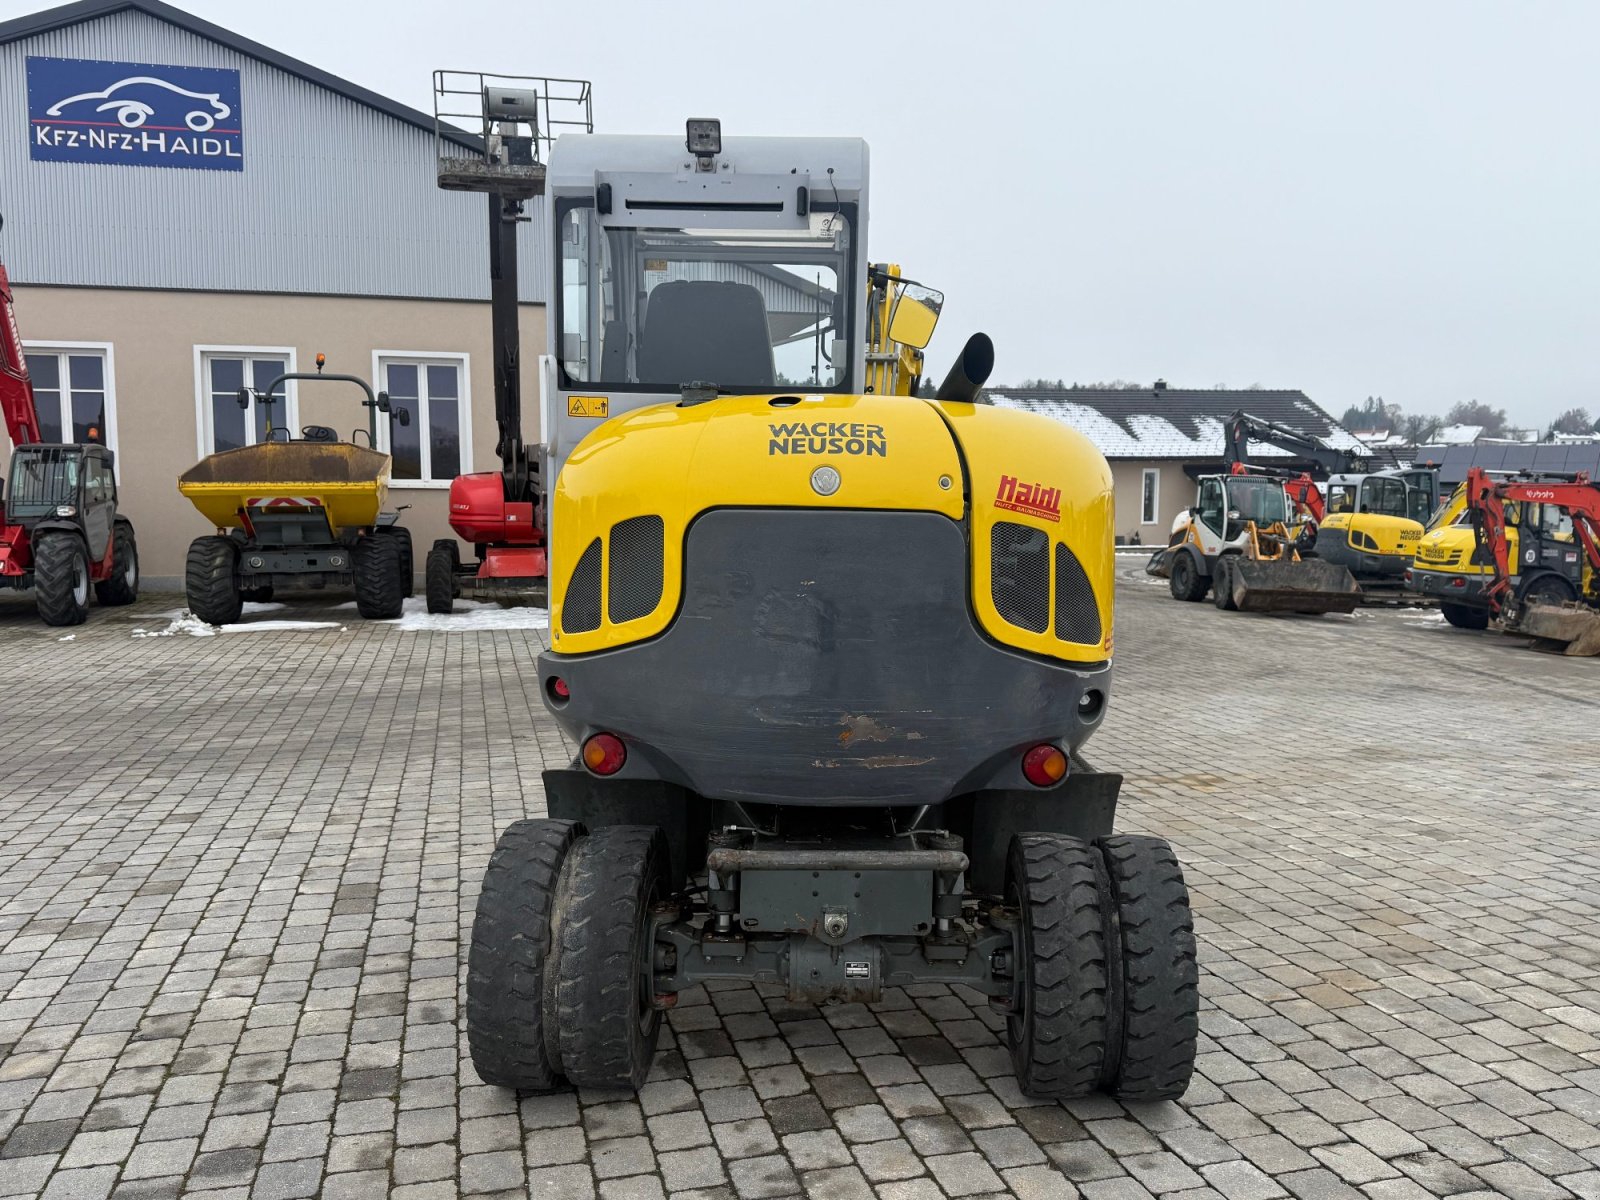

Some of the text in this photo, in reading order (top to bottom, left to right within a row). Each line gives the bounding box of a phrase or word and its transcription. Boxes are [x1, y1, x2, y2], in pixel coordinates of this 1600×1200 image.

[768, 422, 886, 439] WACKER
[768, 437, 887, 457] NEUSON
[996, 474, 1062, 514] Haidl
